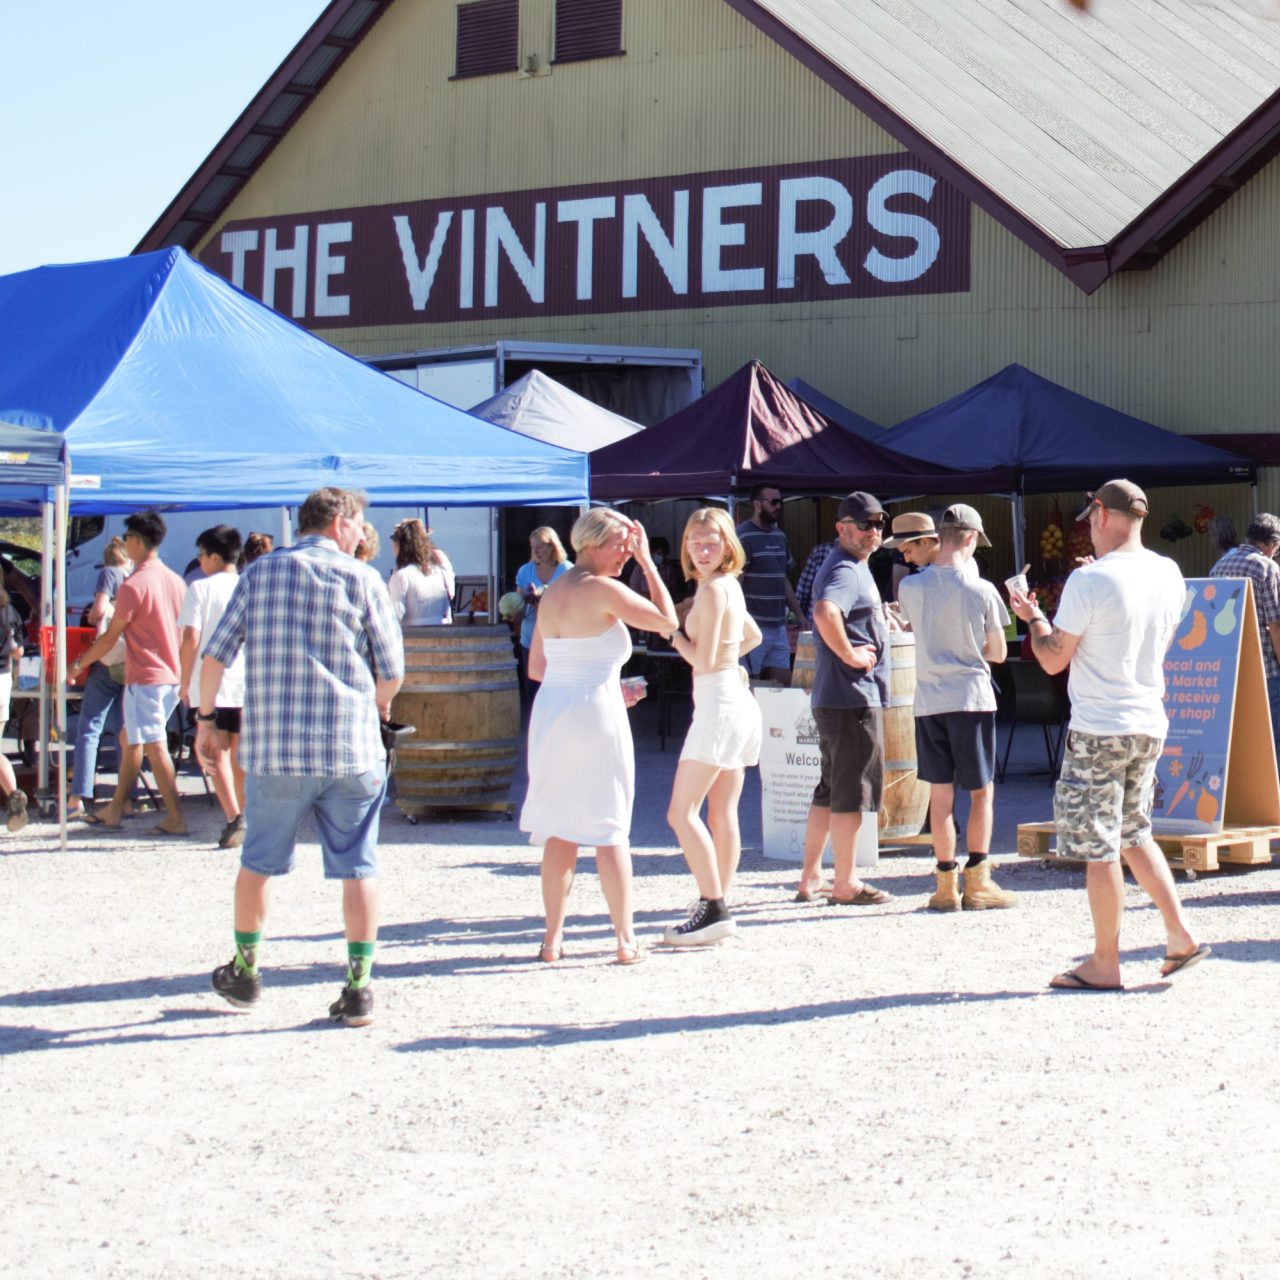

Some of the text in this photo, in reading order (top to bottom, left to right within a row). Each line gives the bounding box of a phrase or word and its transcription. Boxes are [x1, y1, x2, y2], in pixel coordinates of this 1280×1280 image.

[221, 169, 941, 318] THE VINTNERS
[1195, 659, 1221, 672] and
[1172, 676, 1218, 688] Market
[1173, 690, 1221, 704] receive
[1179, 706, 1216, 724] shop!
[785, 753, 820, 767] Welco
